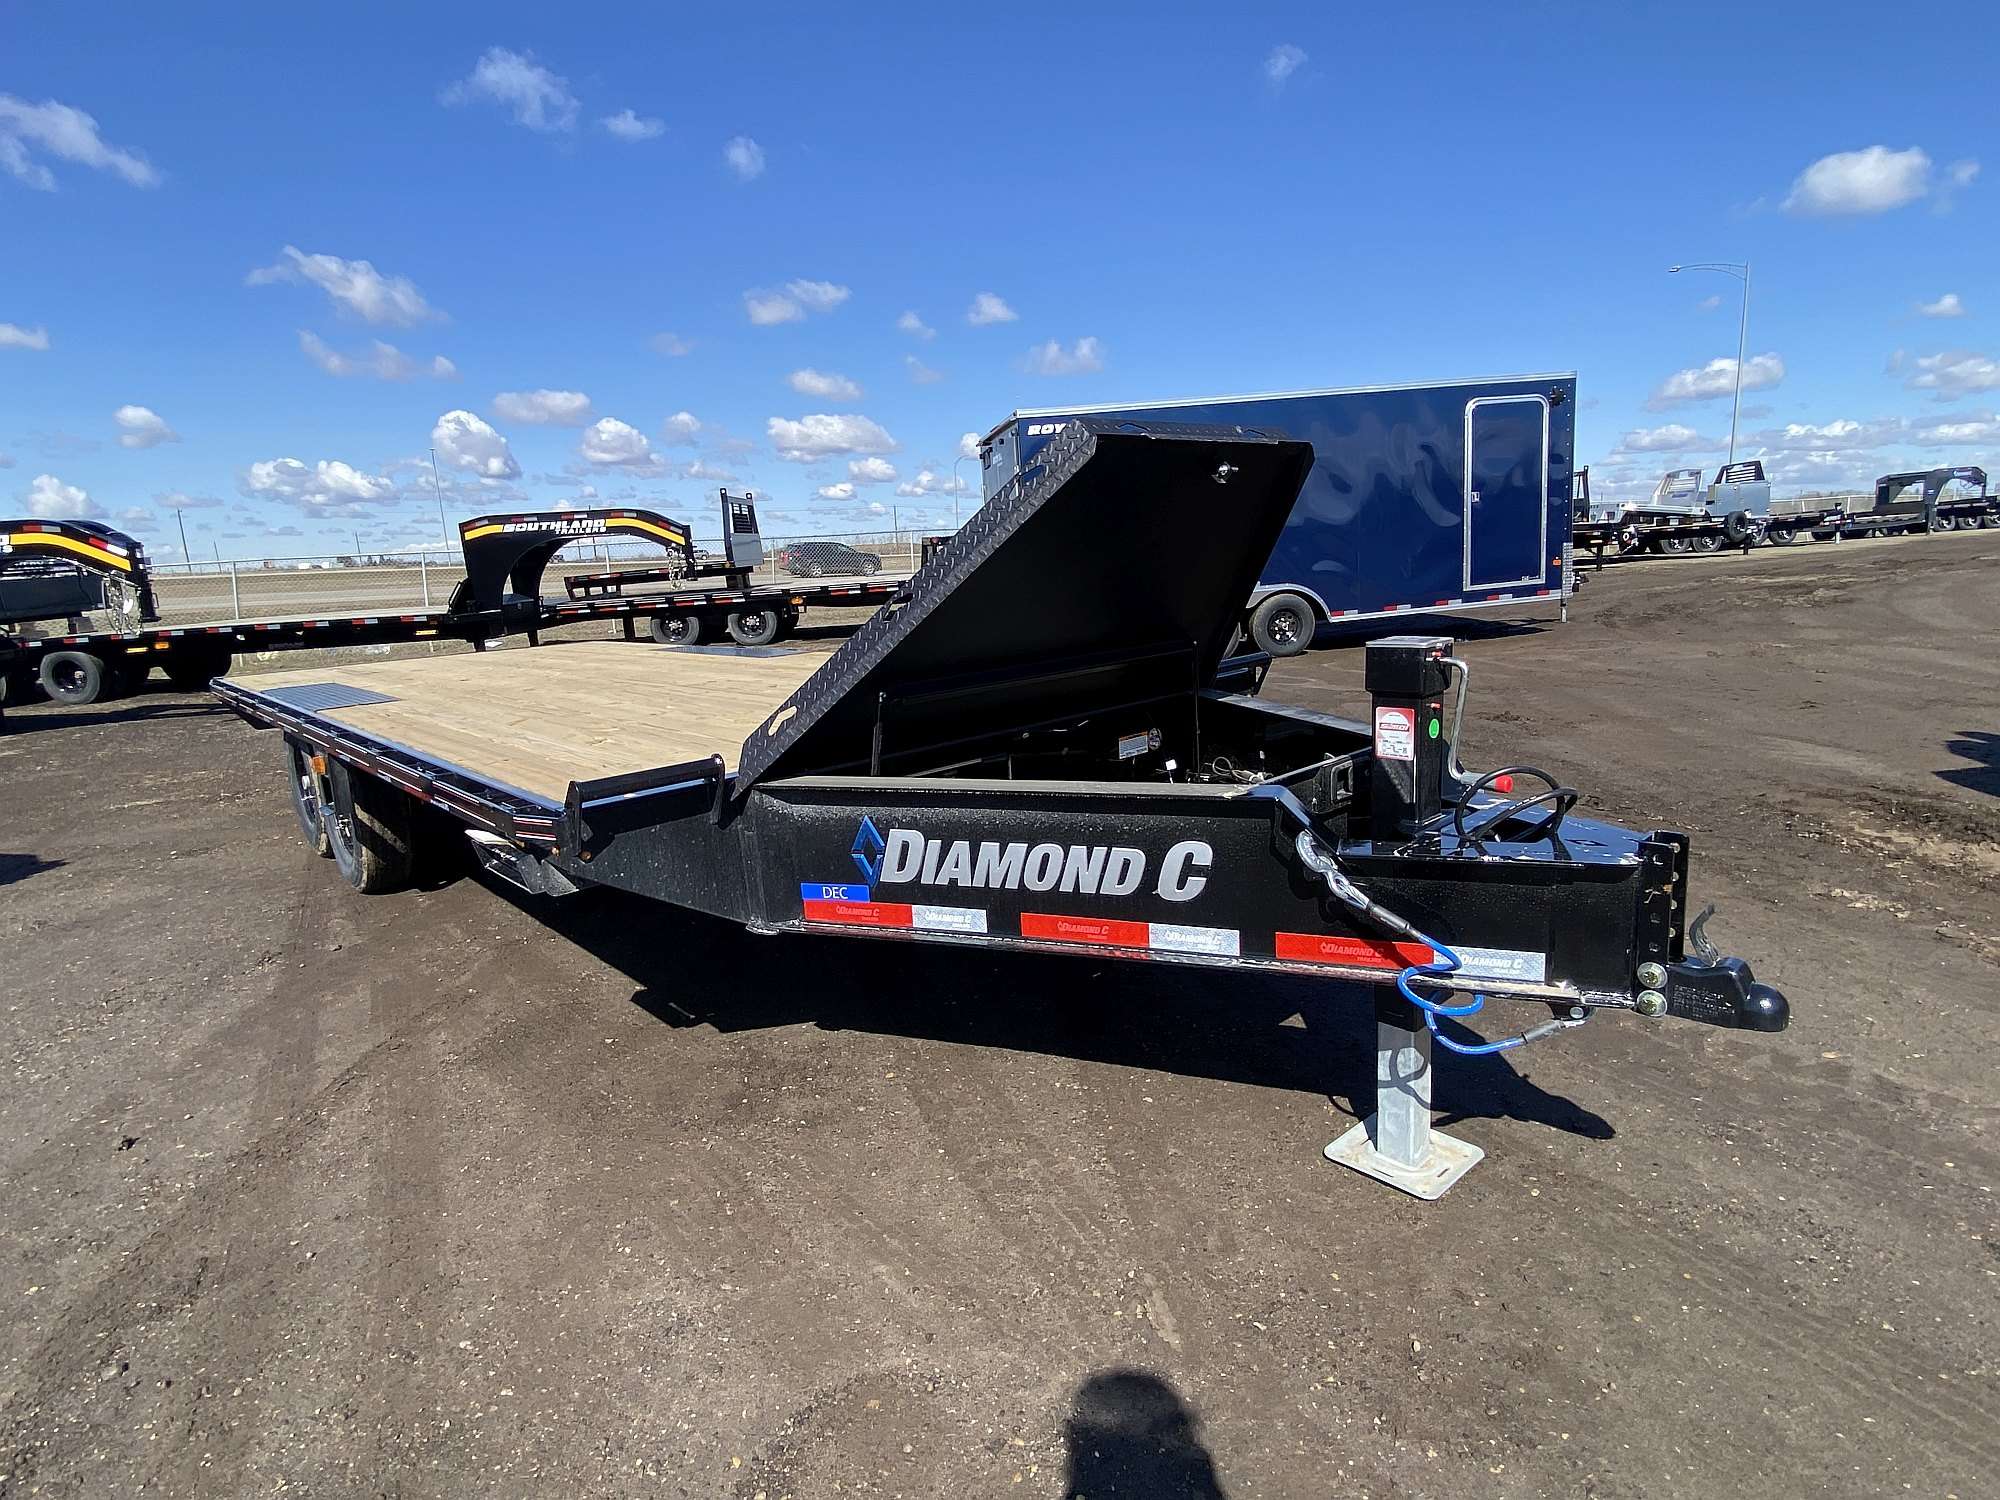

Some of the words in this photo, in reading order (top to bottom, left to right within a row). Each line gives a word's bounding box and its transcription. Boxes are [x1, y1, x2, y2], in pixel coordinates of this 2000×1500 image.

[501, 518, 607, 533] SOUTHLAND
[554, 526, 607, 535] TRAILERS
[879, 828, 1147, 896] DIAMOND
[1157, 840, 1214, 902] C
[822, 886, 849, 899] DEC
[1062, 922, 1101, 934] DIAMOND
[1101, 925, 1109, 935] C
[1327, 943, 1375, 957] DIAMOND
[1463, 954, 1512, 968] DIAMOND
[1512, 958, 1523, 969] C
